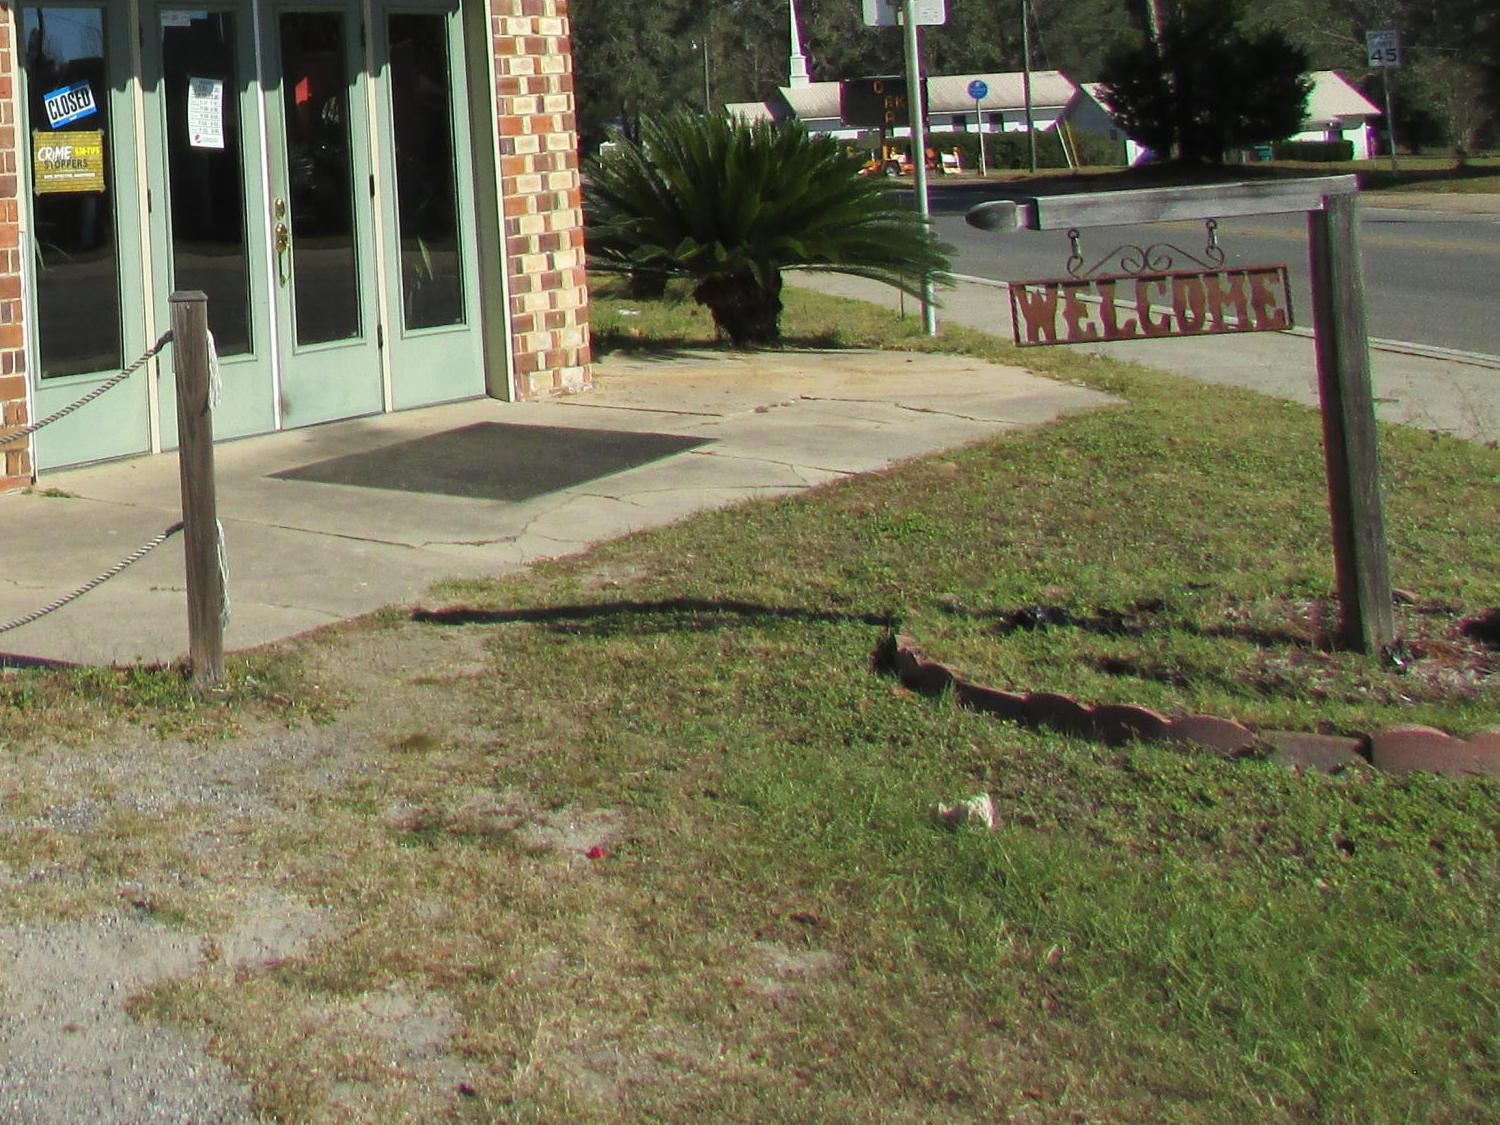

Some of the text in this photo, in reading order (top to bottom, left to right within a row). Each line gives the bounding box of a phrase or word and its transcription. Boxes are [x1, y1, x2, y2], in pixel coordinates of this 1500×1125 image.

[1371, 48, 1397, 62] 45
[47, 87, 91, 121] CLOSED
[1013, 270, 1288, 343] WELCOME
